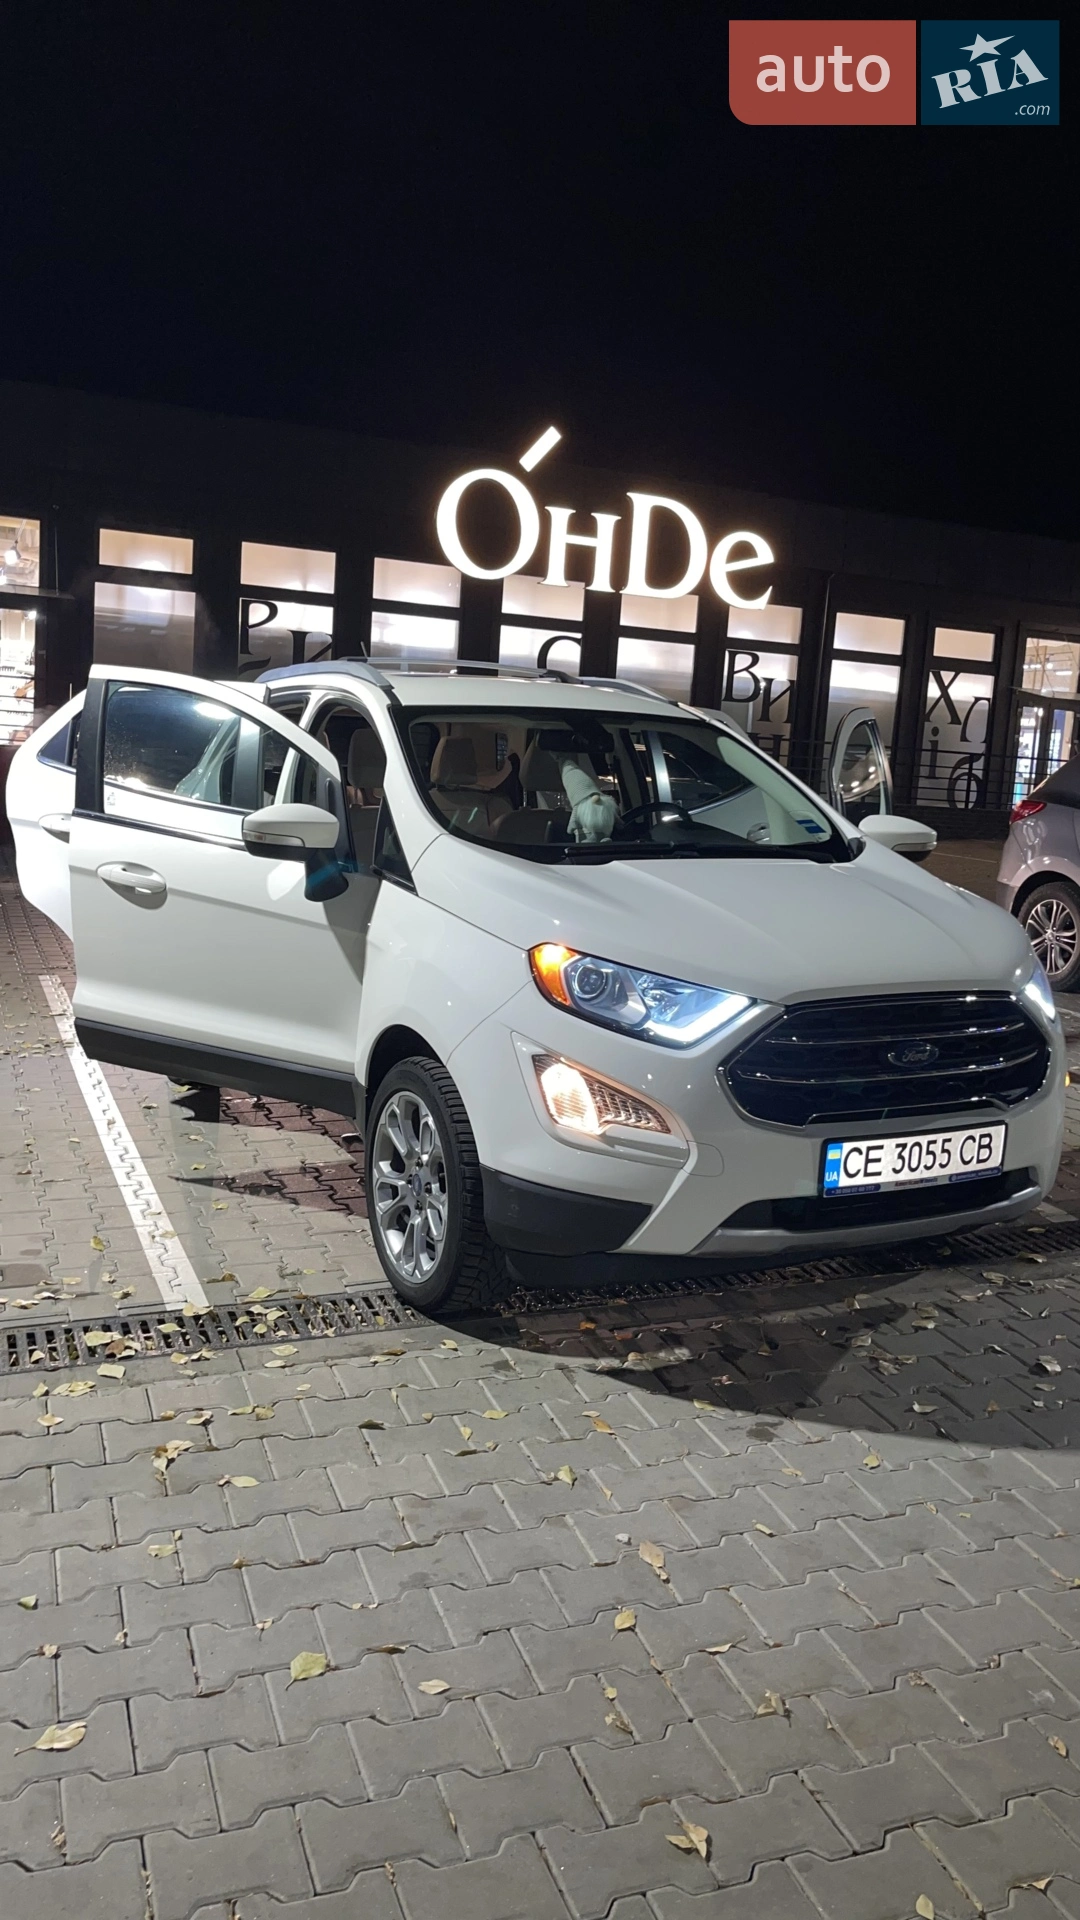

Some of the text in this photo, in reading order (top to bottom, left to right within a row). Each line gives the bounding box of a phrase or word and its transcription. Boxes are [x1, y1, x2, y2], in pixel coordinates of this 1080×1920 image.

[842, 1132, 994, 1178] CE 3055 CB
[825, 1170, 839, 1182] UA
